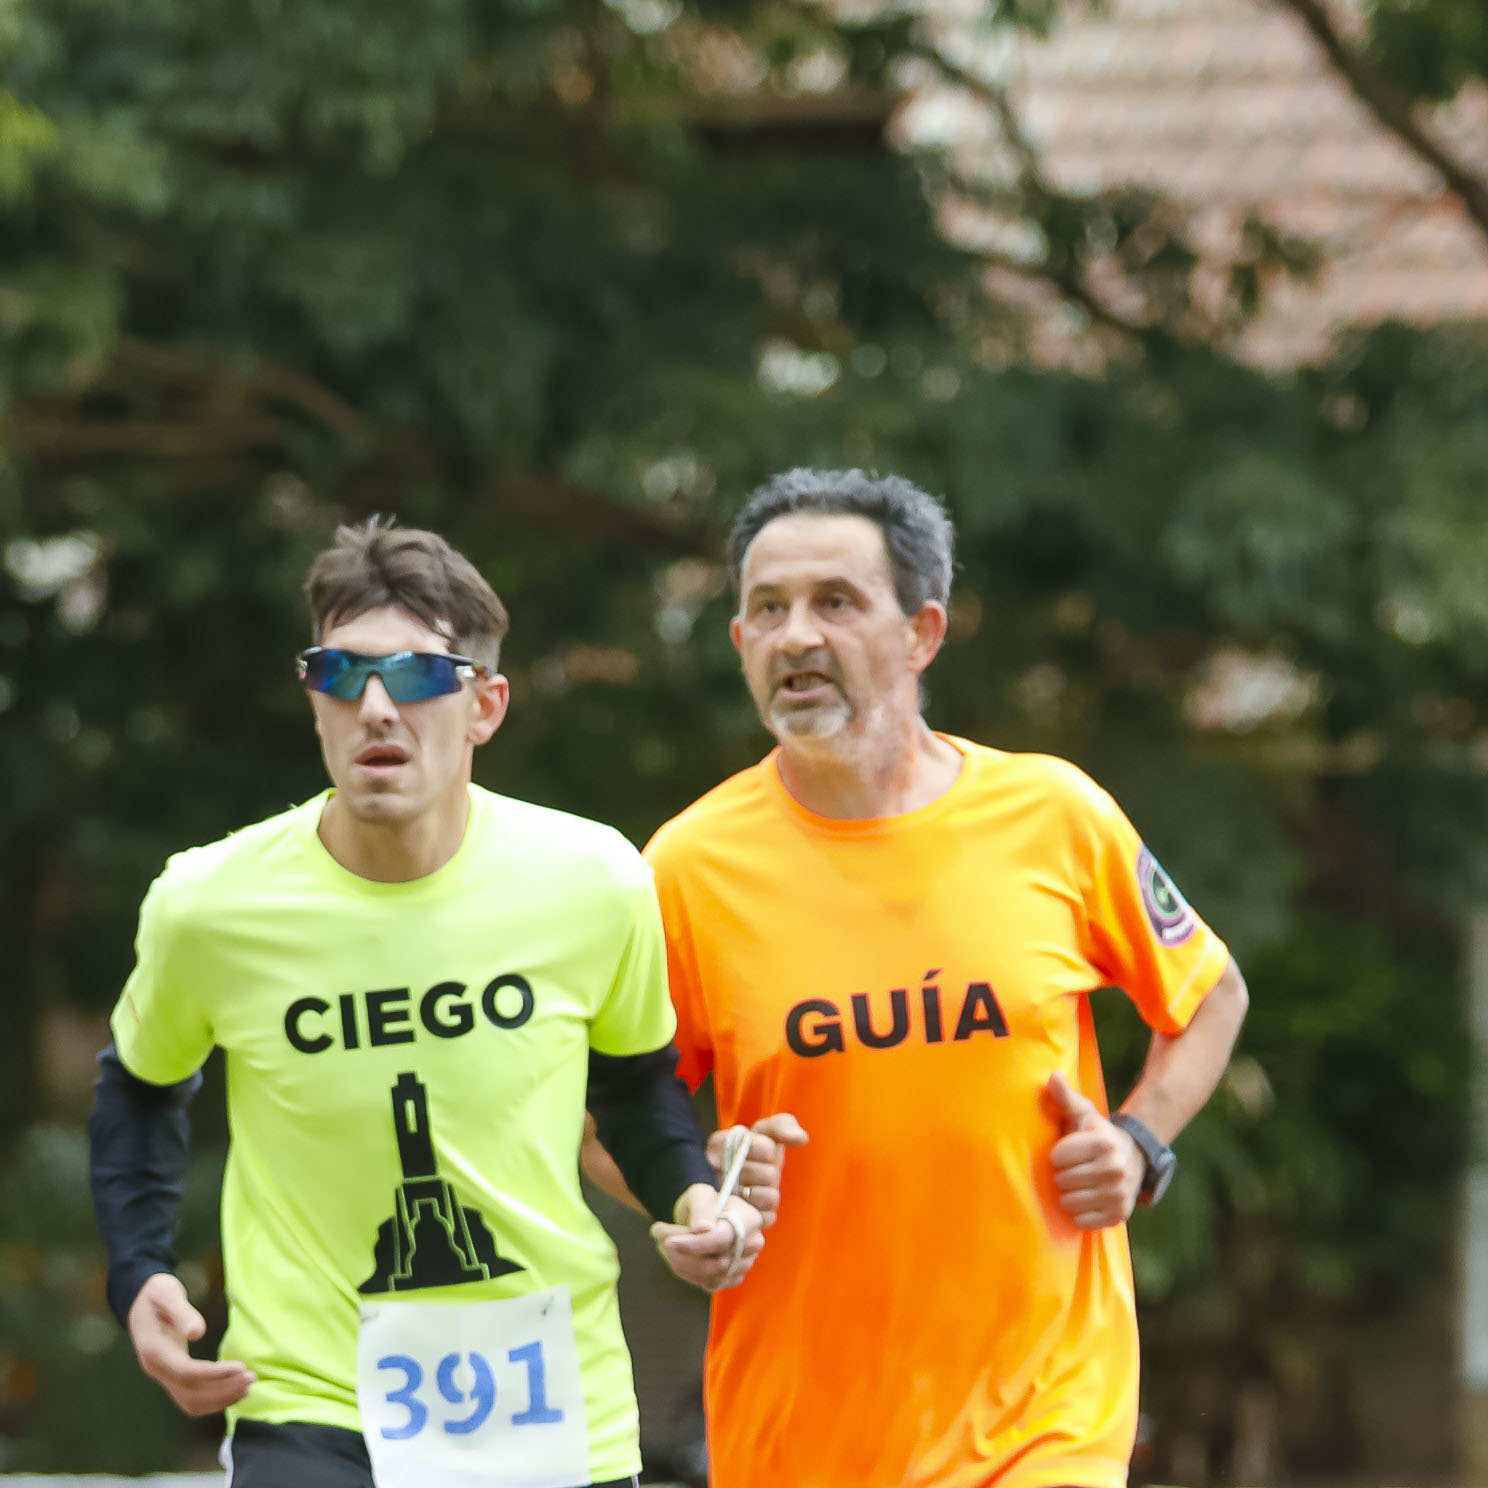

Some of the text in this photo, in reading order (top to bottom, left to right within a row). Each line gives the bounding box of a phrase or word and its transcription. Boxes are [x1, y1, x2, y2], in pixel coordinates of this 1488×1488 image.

[284, 973, 535, 1054] CIEGO
[784, 968, 1010, 1059] GUÍA
[376, 1340, 565, 1440] 391
